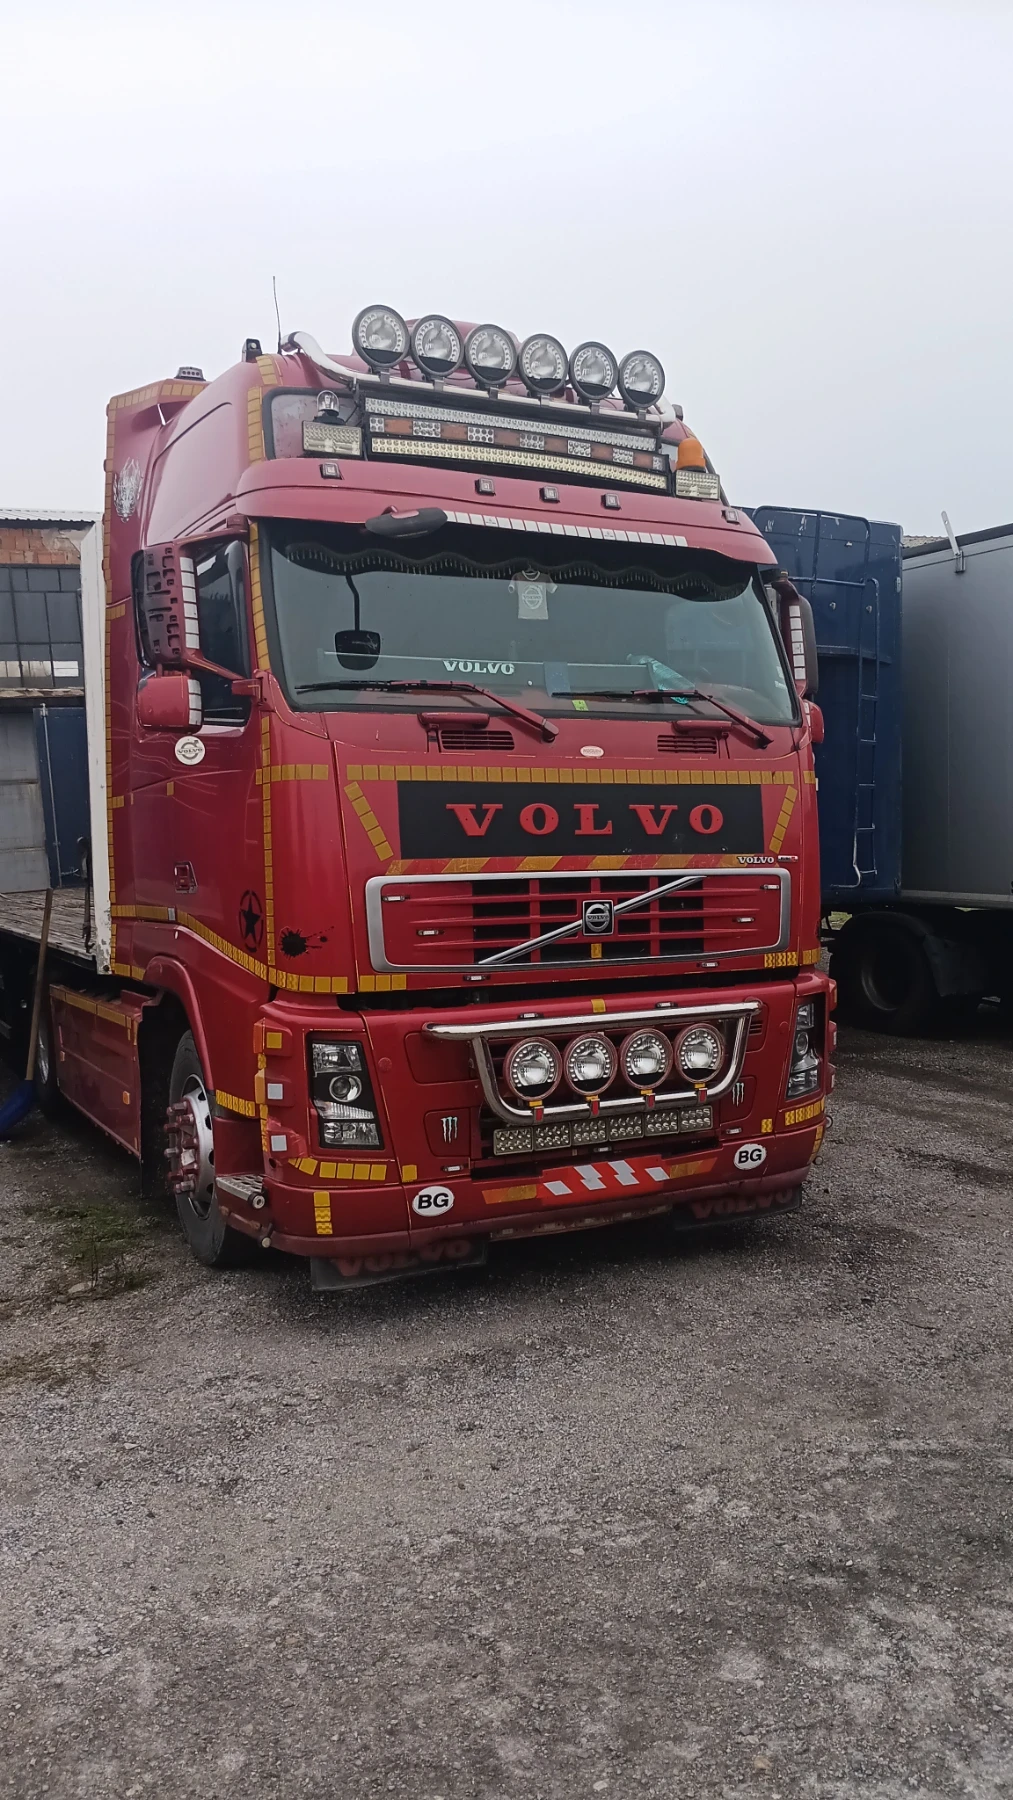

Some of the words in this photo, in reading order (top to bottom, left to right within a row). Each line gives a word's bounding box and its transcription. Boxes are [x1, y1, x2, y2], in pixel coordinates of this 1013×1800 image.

[443, 660, 515, 675] VOLVO
[445, 803, 724, 836] VOLVO
[737, 856, 775, 864] VOLVO
[737, 1148, 762, 1164] BG
[417, 1192, 449, 1209] BG
[330, 1239, 471, 1277] VOLVO
